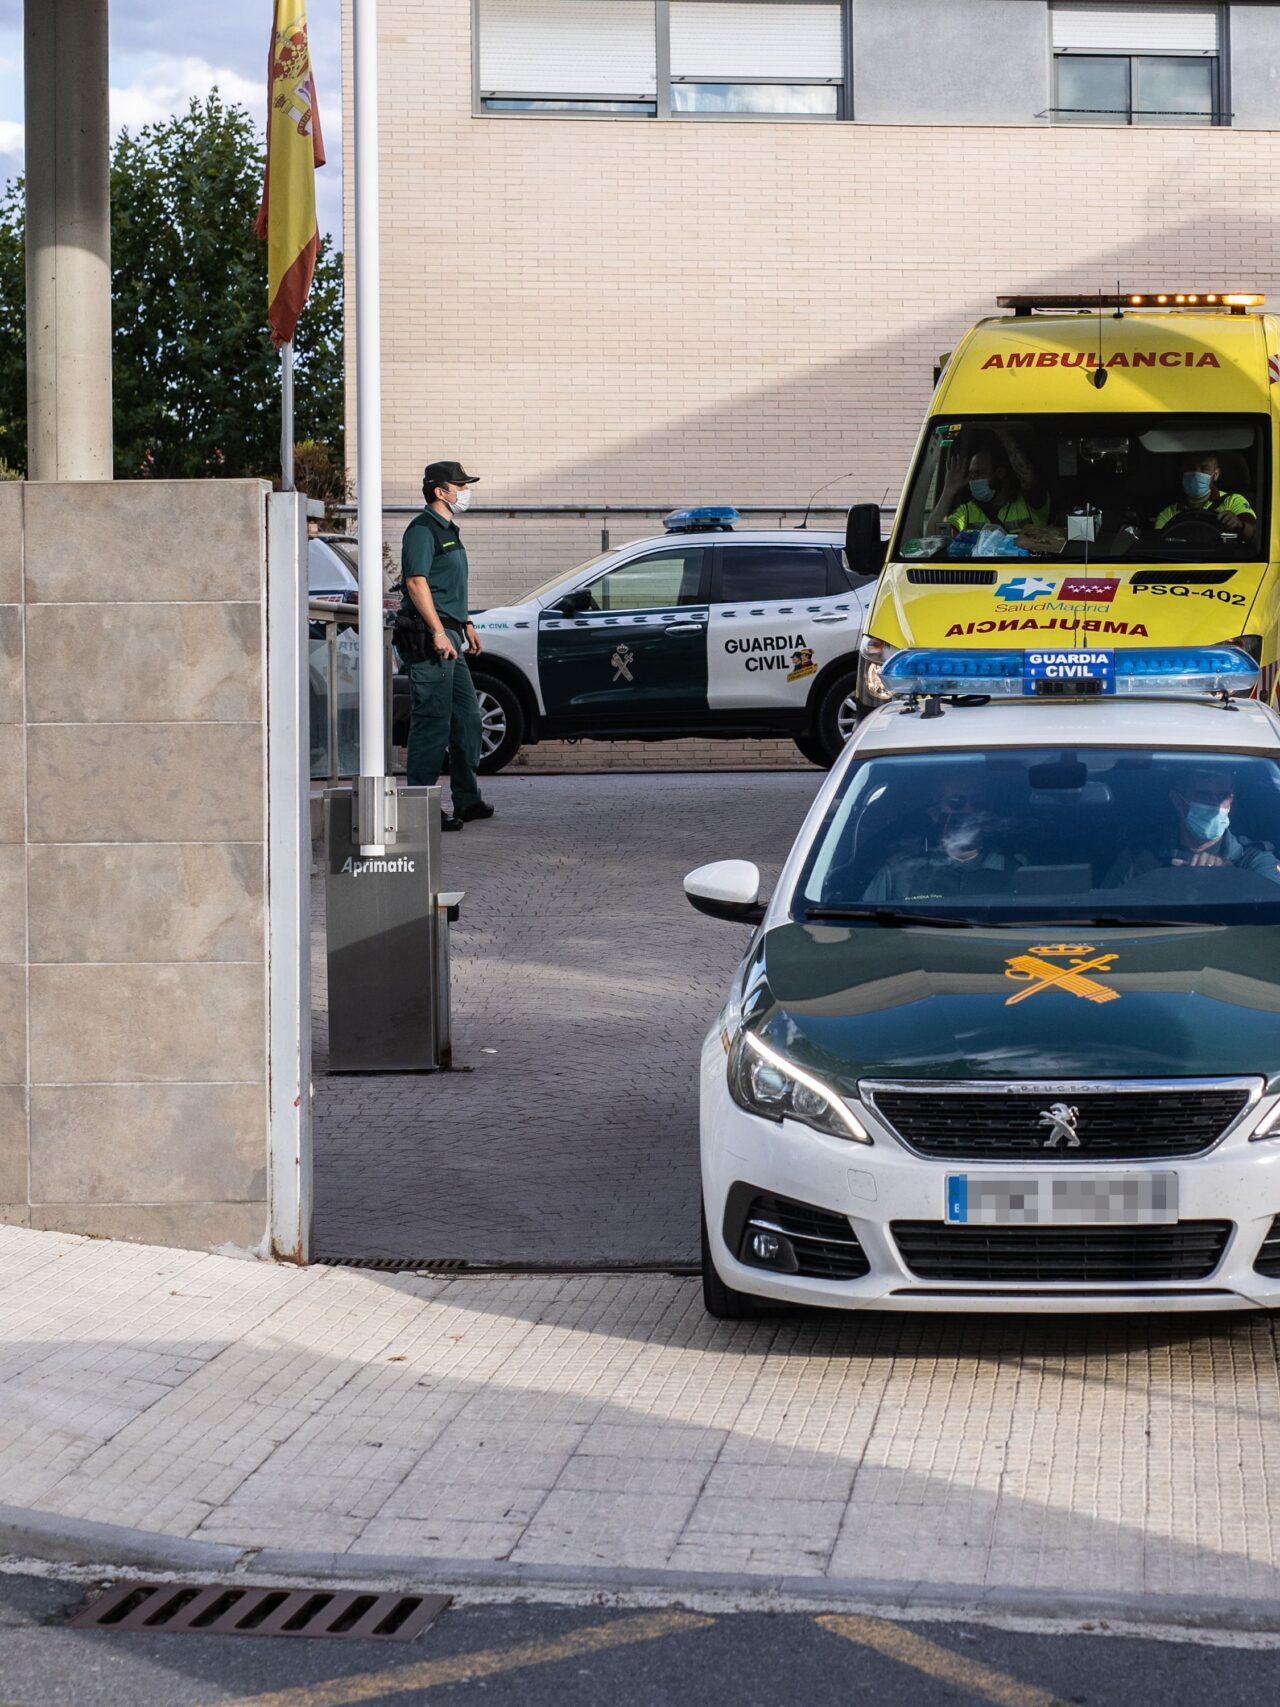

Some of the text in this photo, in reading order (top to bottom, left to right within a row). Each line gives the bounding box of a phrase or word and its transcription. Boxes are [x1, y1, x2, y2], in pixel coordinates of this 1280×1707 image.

[980, 351, 1221, 370] AMBULANCIA
[1132, 584, 1247, 606] PSQ-402
[994, 602, 1110, 613] SaludMadrid
[724, 634, 807, 654] GUARDIA
[745, 655, 790, 672] CIVIL
[1029, 654, 1109, 664] GUARDIA
[1045, 665, 1093, 677] CIVIL
[340, 856, 415, 877] Aprimatic
